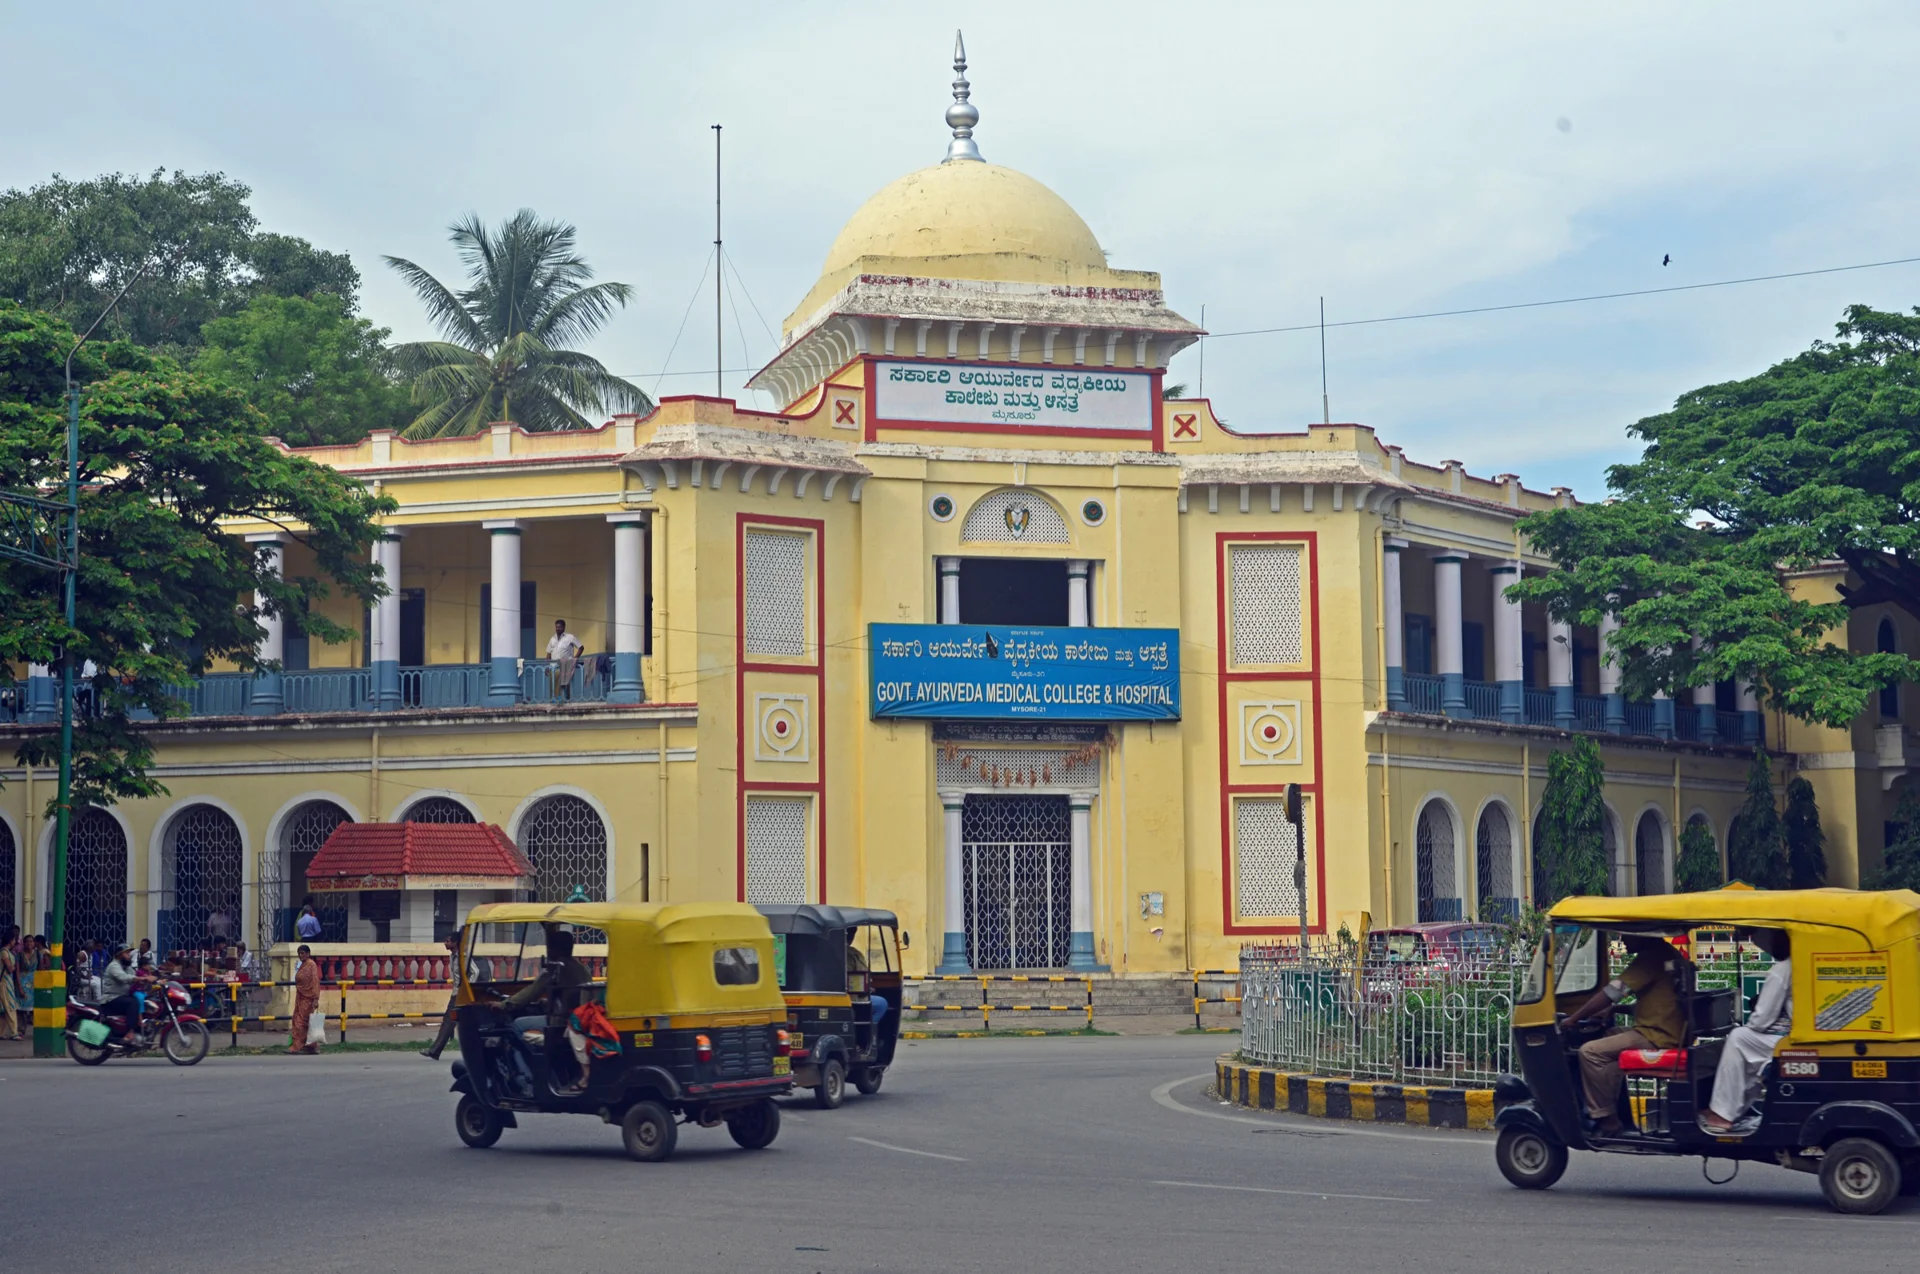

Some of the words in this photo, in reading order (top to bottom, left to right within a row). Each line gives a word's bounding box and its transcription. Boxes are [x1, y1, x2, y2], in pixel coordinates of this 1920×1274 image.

[889, 366, 951, 385] ಸರ್ಕಾರಿ
[959, 370, 1044, 389] ಆಯುರ್ವೇದ
[1051, 374, 1127, 395] ವೈದ್ಯಕೀಯ
[945, 387, 999, 406] ಕಾಲೇಜು
[1003, 391, 1042, 412] ಮತ್ತು
[1045, 391, 1080, 413] ಆಸ್ಪತ್ರೆ
[992, 410, 1036, 422] ಮೈಸೂರು
[882, 639, 923, 658] ಸರ್ಕಾರಿ
[928, 637, 999, 659] ಆಯುರ್ವೇ
[1004, 638, 1059, 668] ವೈದ್ಯಕೀಯ
[1065, 640, 1109, 661] ಕಾಲೇಜು
[1115, 650, 1134, 667] ಮತ್ತು
[1139, 641, 1169, 671] ಆಸ್ಪತ್ರೆ
[877, 682, 914, 702] GOVT.
[916, 682, 983, 702] AYURVEDA
[986, 683, 1041, 703] MEDICAL
[1043, 684, 1100, 704] COLLEGE
[1103, 685, 1112, 704] &
[1115, 685, 1174, 705] HOSPITAL
[1781, 1062, 1818, 1075] 1580
